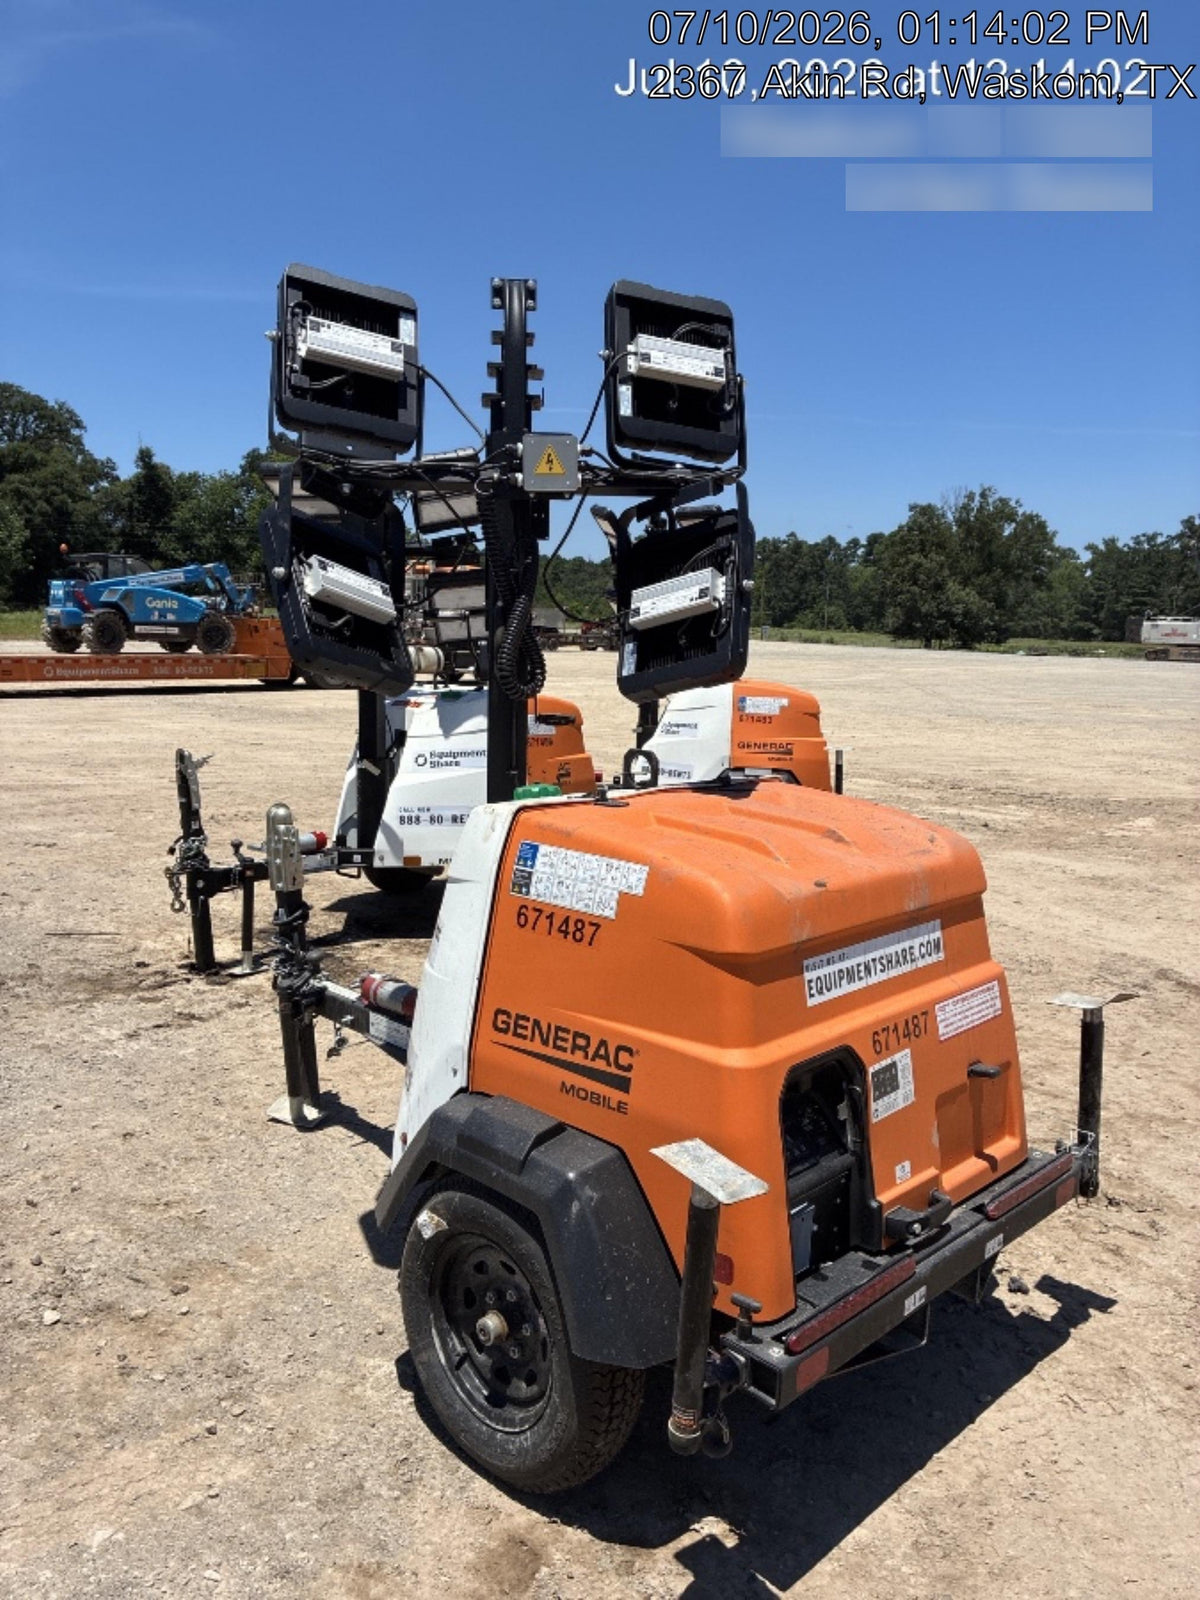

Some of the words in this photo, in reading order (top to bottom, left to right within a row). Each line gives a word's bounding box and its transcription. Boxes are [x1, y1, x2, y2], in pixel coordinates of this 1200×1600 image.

[145, 596, 179, 609] Genie
[516, 904, 602, 946] 671487
[807, 936, 943, 999] EQUIPMENTSHARE.COM
[492, 1008, 634, 1073] GENERAC
[871, 1011, 929, 1055] 671487
[559, 1080, 630, 1116] MOBILE
